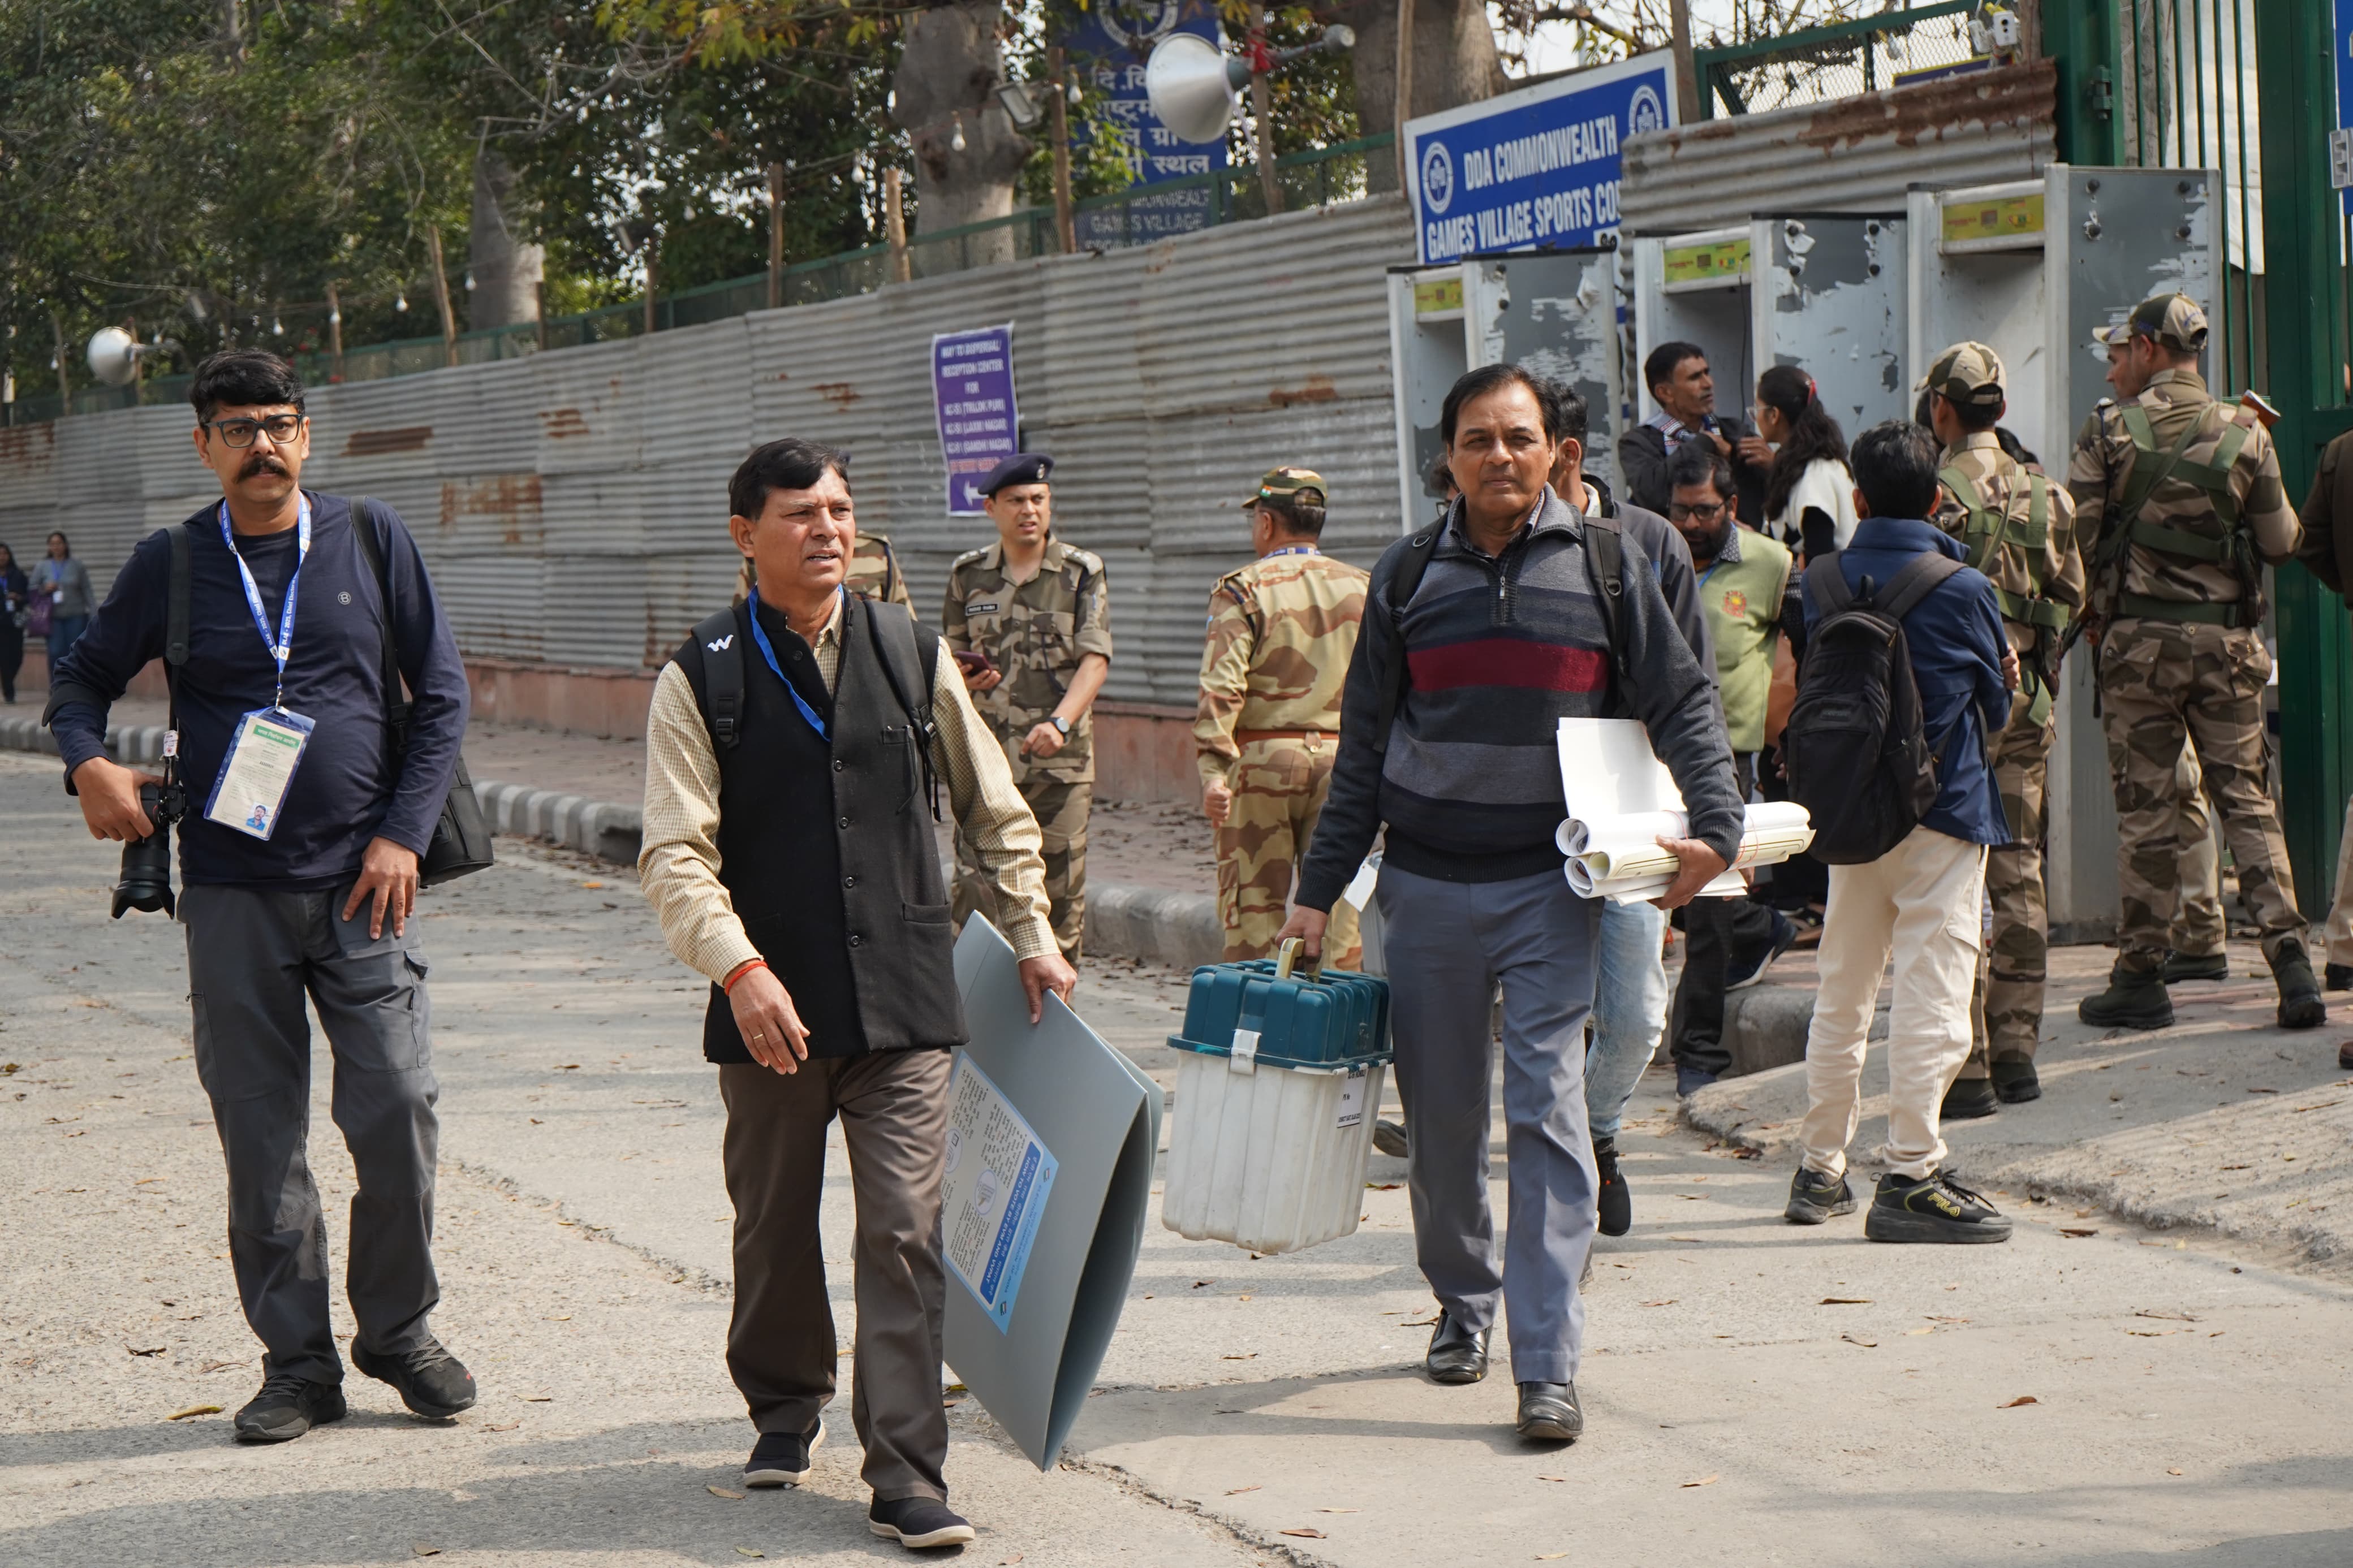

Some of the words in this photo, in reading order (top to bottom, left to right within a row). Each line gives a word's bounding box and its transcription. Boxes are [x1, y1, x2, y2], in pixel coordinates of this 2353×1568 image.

[1153, 155, 1210, 174] स्थल
[1464, 148, 1494, 192] DDA
[1495, 114, 1618, 183] COMMONWEALTH
[1091, 213, 1141, 232] GAMS
[1427, 213, 1475, 262] GAMES
[1476, 200, 1532, 249] VILLAGE
[1535, 185, 1592, 237] SPORTS
[1022, 1155, 1031, 1177] HOW
[1010, 1187, 1019, 1211] VOTE
[1927, 1192, 1961, 1217] FILA
[999, 1221, 1008, 1242] EVM
[985, 1258, 996, 1284] VVPAT
